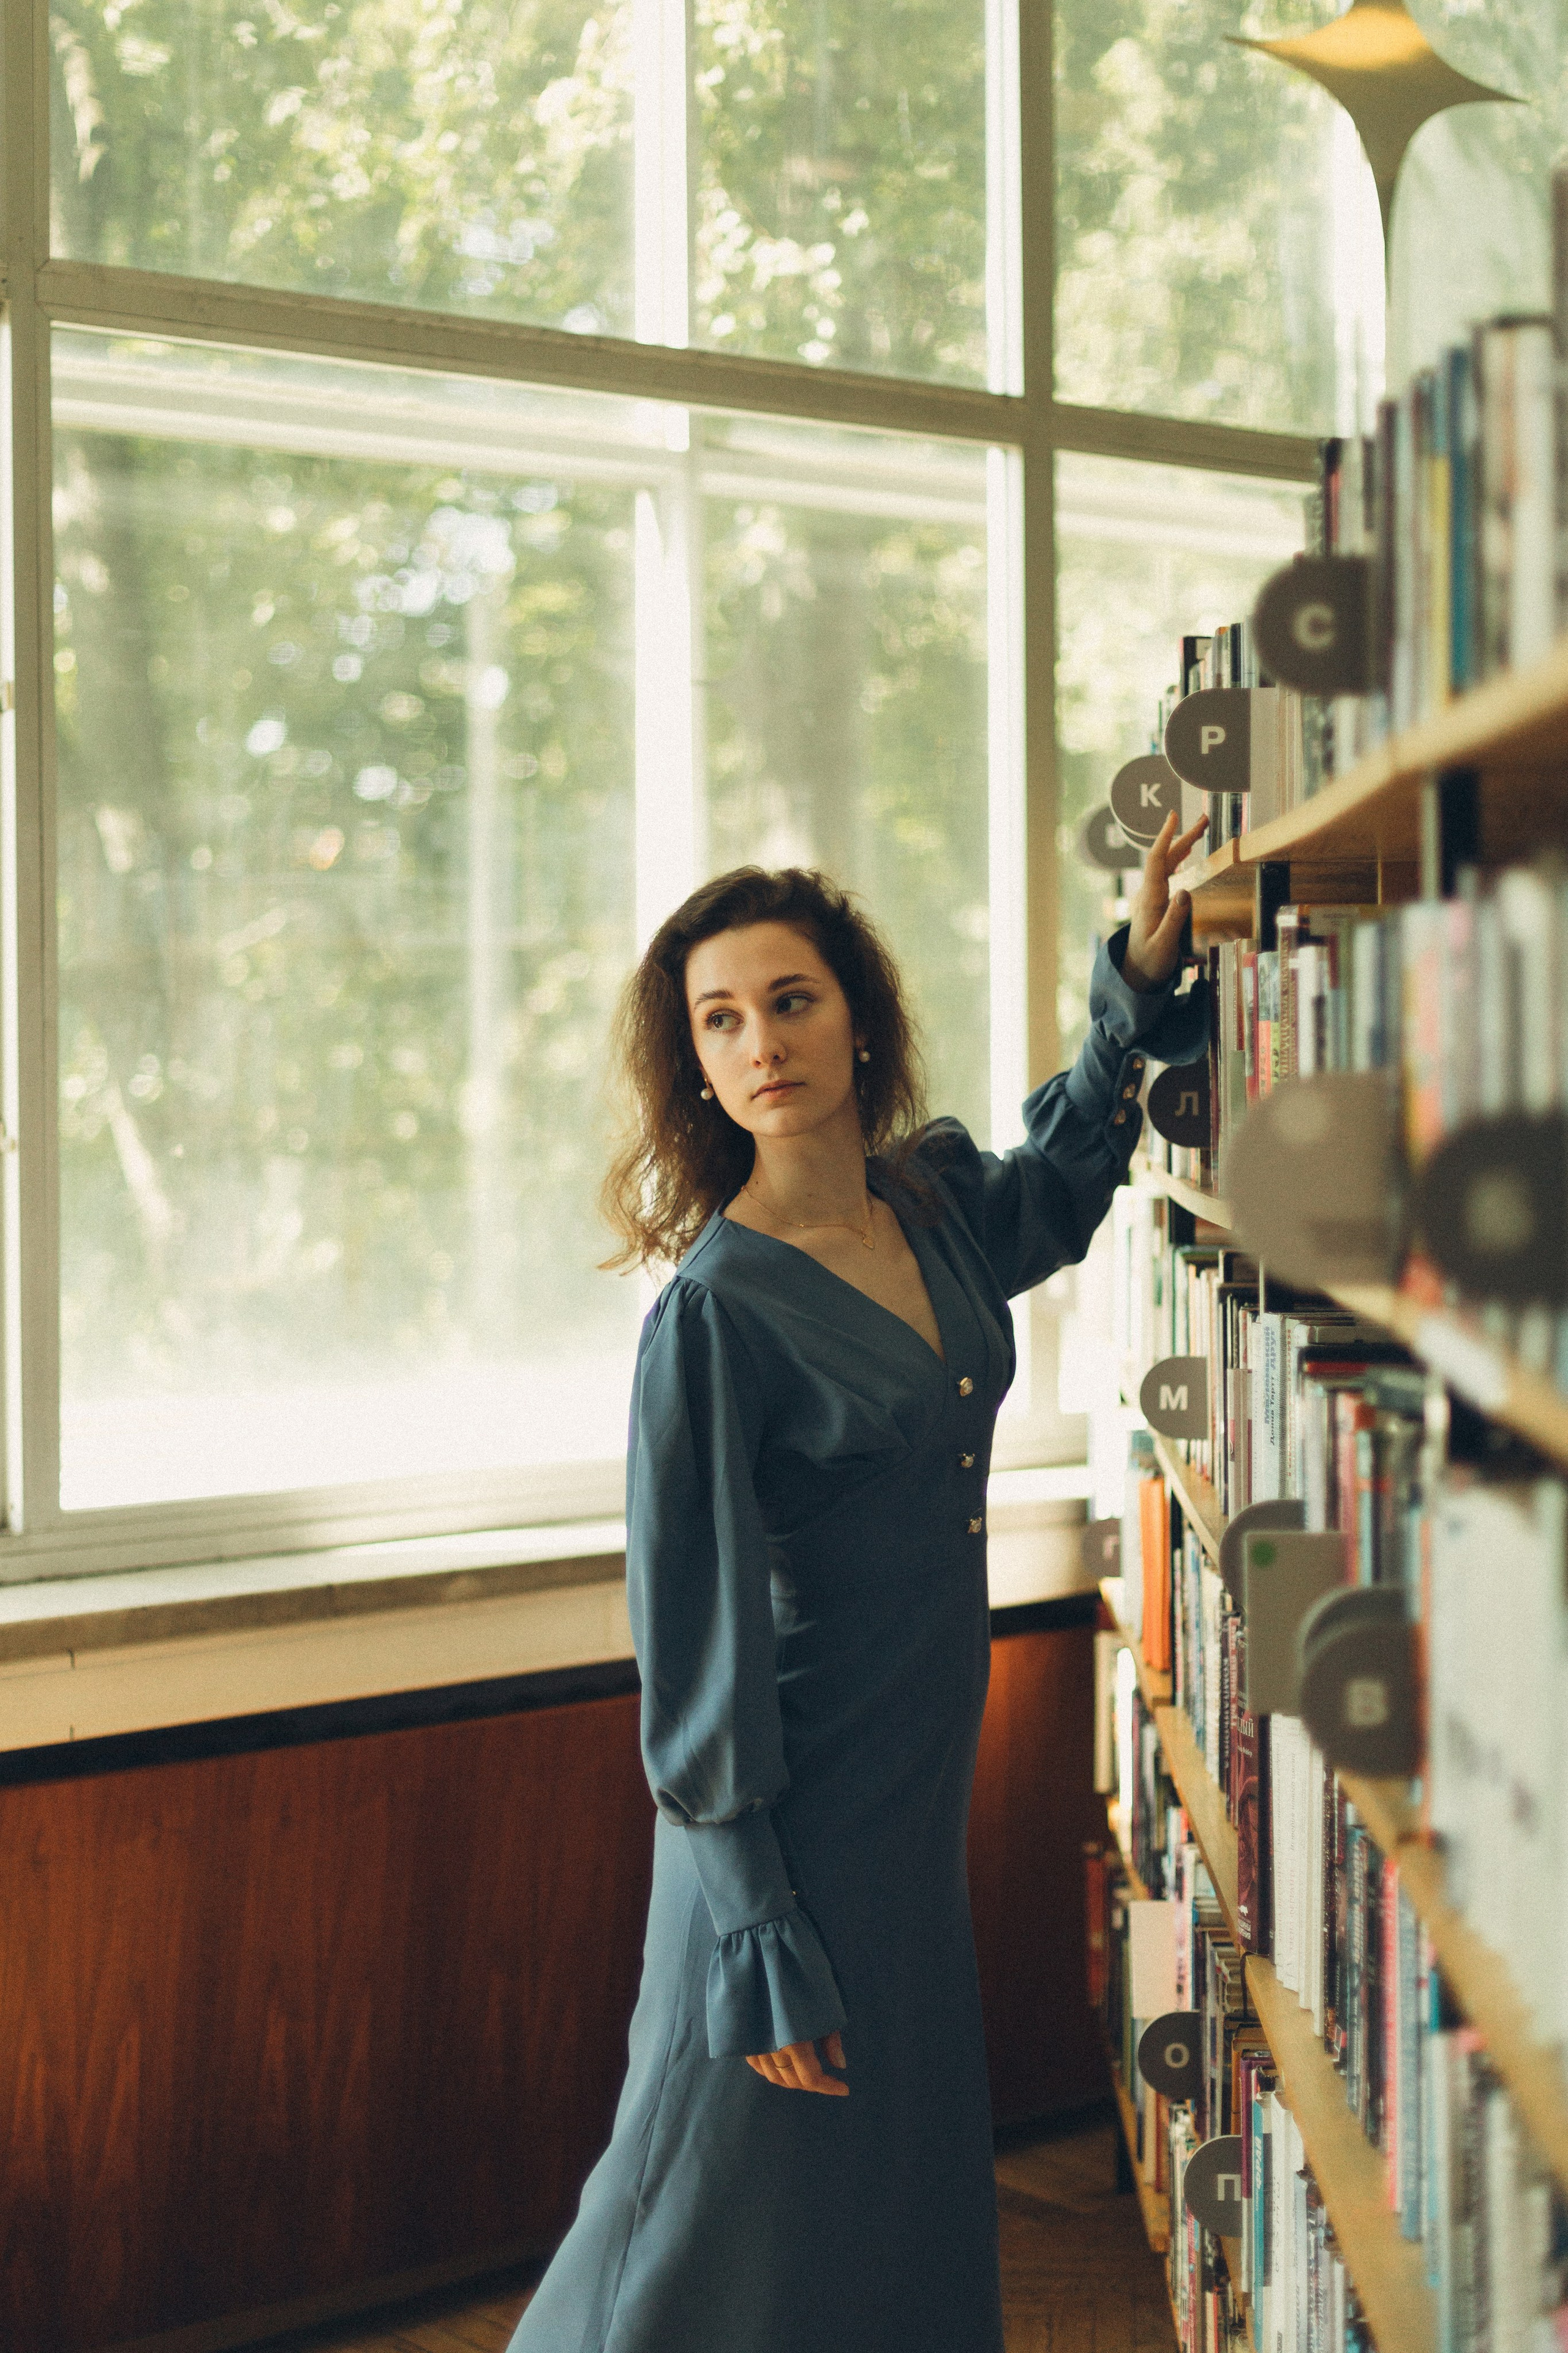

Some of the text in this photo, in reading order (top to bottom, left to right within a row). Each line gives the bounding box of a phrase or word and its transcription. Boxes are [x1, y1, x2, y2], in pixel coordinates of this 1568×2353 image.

[1292, 603, 1334, 650] С
[1200, 725, 1226, 754] Р
[1140, 784, 1161, 807] К
[1175, 1091, 1199, 1116] Л
[1159, 1385, 1188, 1410] М
[1164, 2042, 1189, 2069] О
[1217, 2174, 1242, 2200] П
